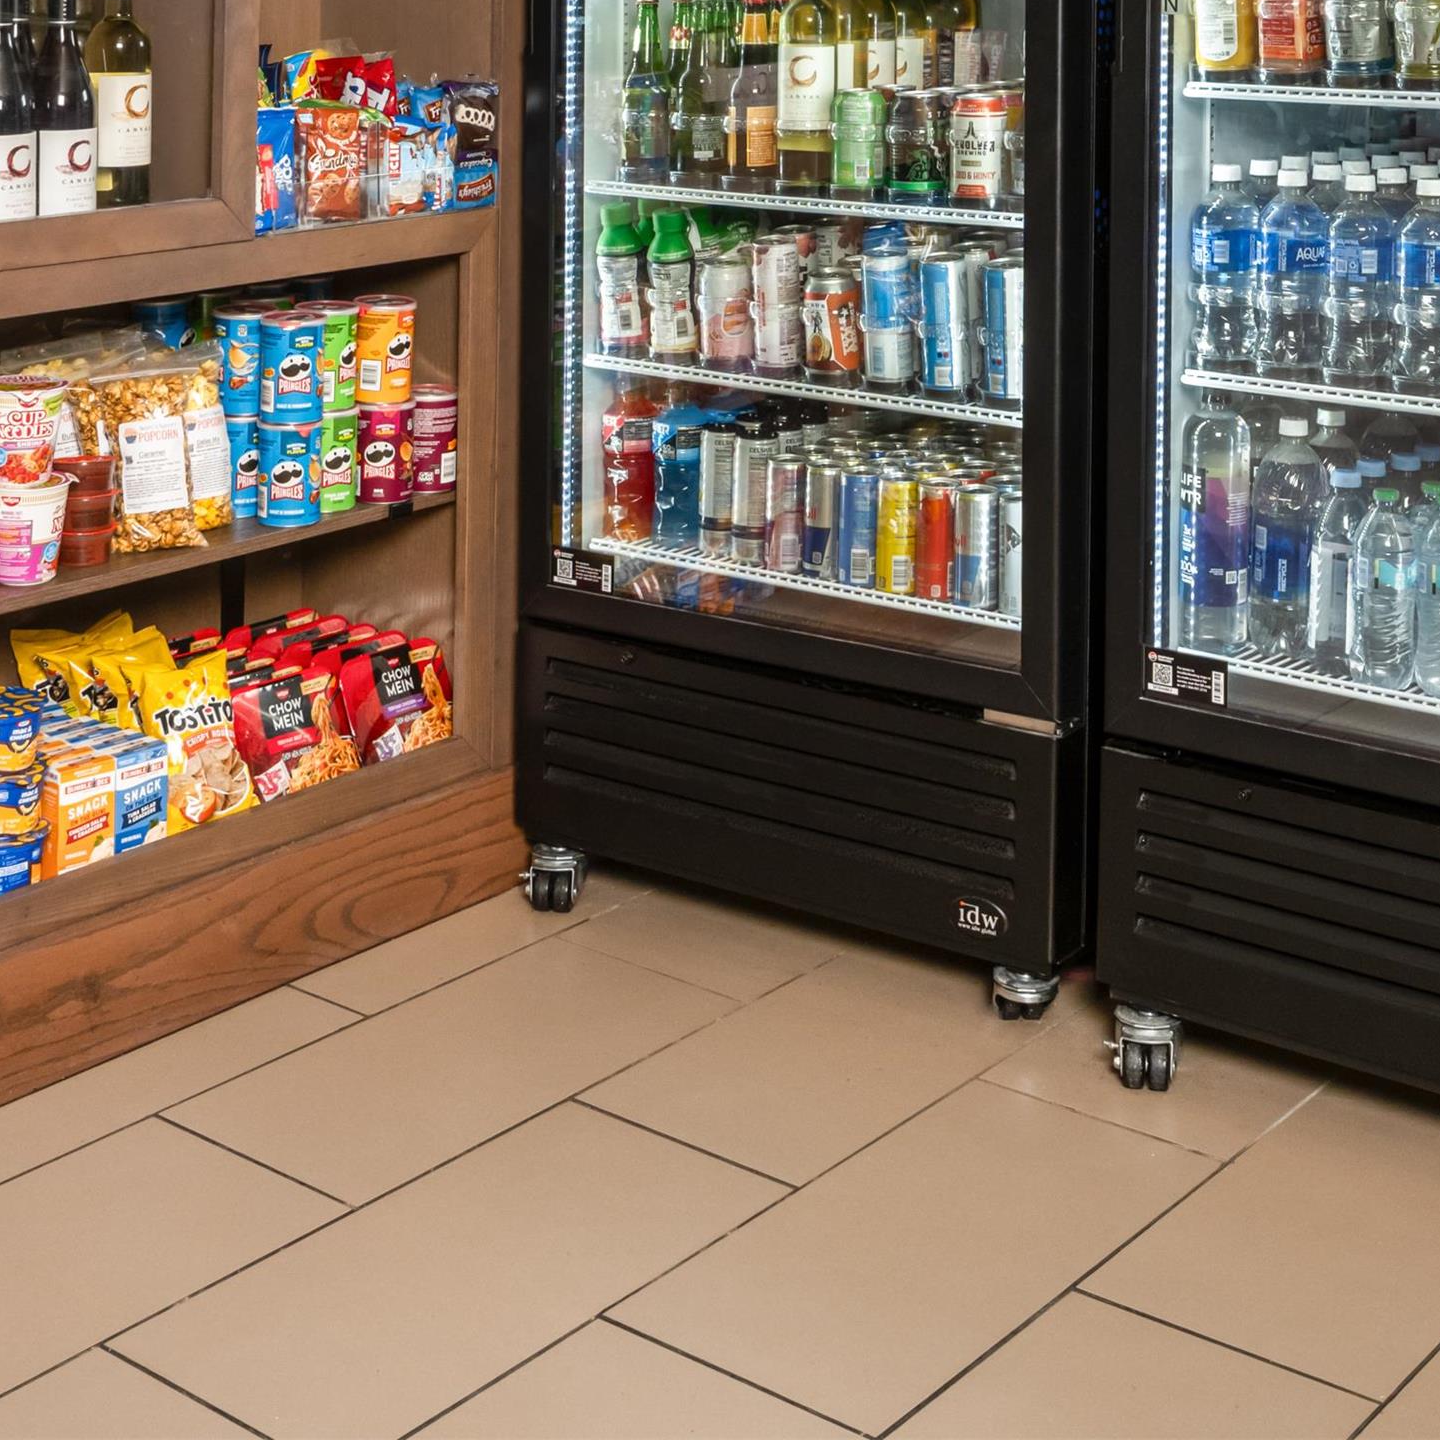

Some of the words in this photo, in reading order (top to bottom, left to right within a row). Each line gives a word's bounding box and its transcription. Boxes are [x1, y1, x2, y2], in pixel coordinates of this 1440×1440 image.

[278, 378, 311, 394] PRINGLES
[8, 411, 45, 425] CUP
[197, 417, 223, 429] POPCORN
[138, 430, 178, 442] POPCORN
[138, 449, 166, 458] Caramel
[322, 472, 351, 485] PRINGLES
[364, 465, 395, 478] PRINGLES
[271, 485, 303, 499] PRINGLES
[381, 664, 411, 683] CHOW
[386, 678, 415, 697] MEIN
[269, 698, 301, 716] CHOW
[273, 710, 305, 731] MEIN
[186, 732, 209, 746] CRISPY
[123, 780, 161, 804] SNACK
[68, 794, 109, 819] SNACK
[959, 900, 999, 929] idw
